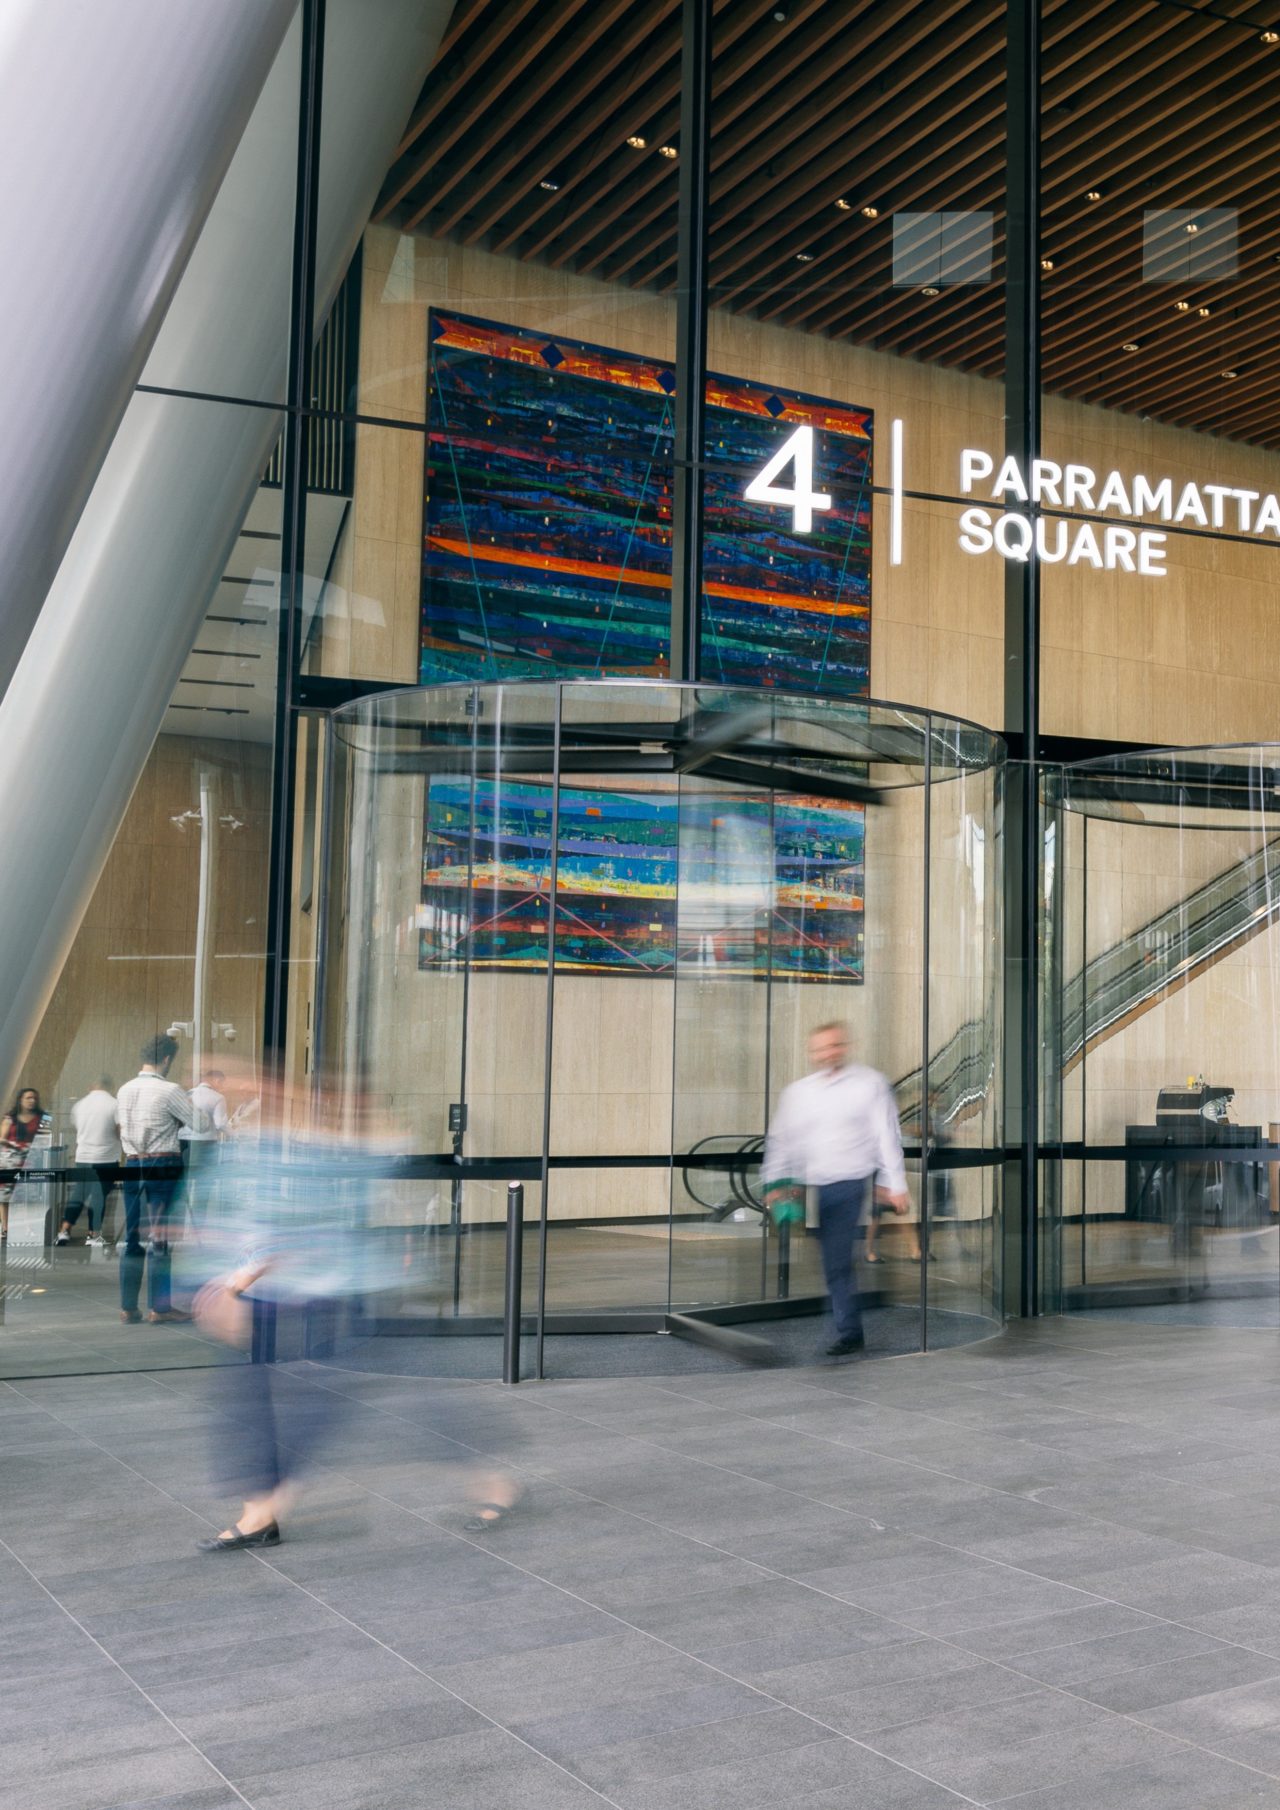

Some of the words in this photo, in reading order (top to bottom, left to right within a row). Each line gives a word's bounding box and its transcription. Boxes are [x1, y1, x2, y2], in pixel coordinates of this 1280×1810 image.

[744, 426, 832, 533] 4
[959, 508, 1168, 576] SQUARE
[14, 1172, 21, 1181] 4
